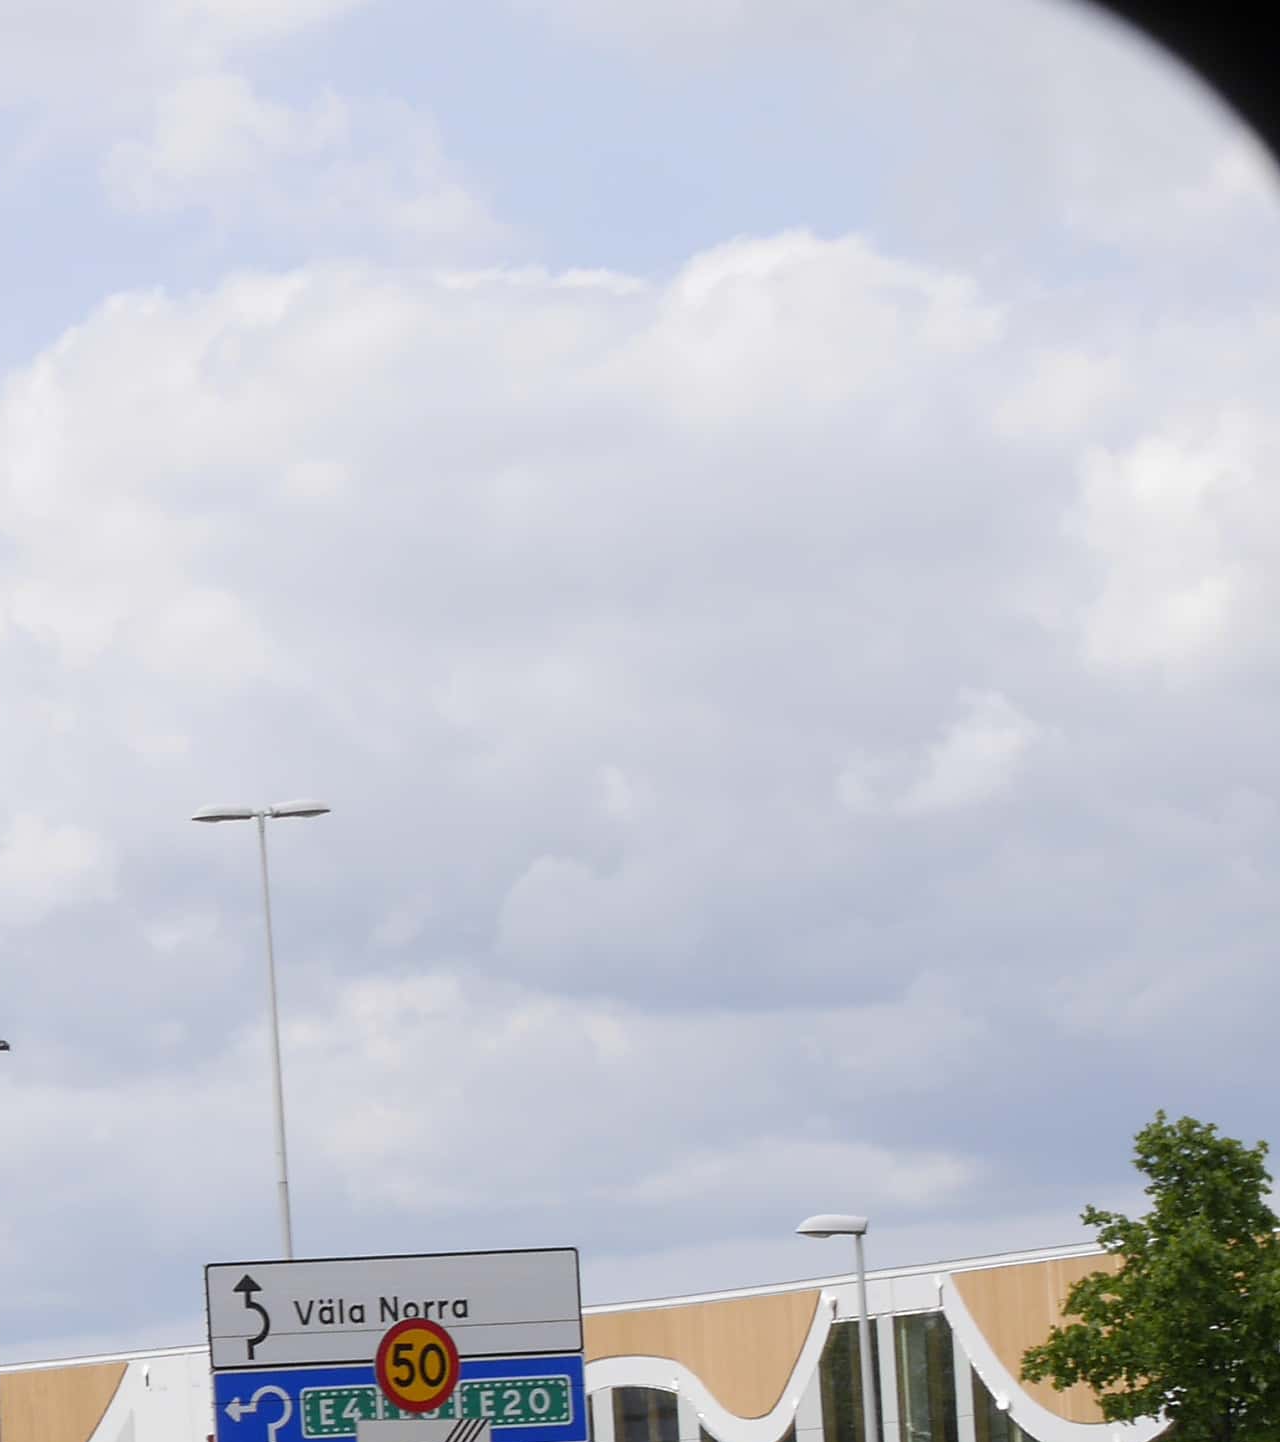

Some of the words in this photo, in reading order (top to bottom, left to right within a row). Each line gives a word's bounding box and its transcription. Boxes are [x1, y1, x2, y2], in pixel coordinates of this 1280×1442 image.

[293, 1298, 365, 1325] Väla
[379, 1296, 468, 1323] Norra
[392, 1343, 446, 1388] 50
[319, 1398, 363, 1426] E4
[479, 1387, 551, 1418] E20
